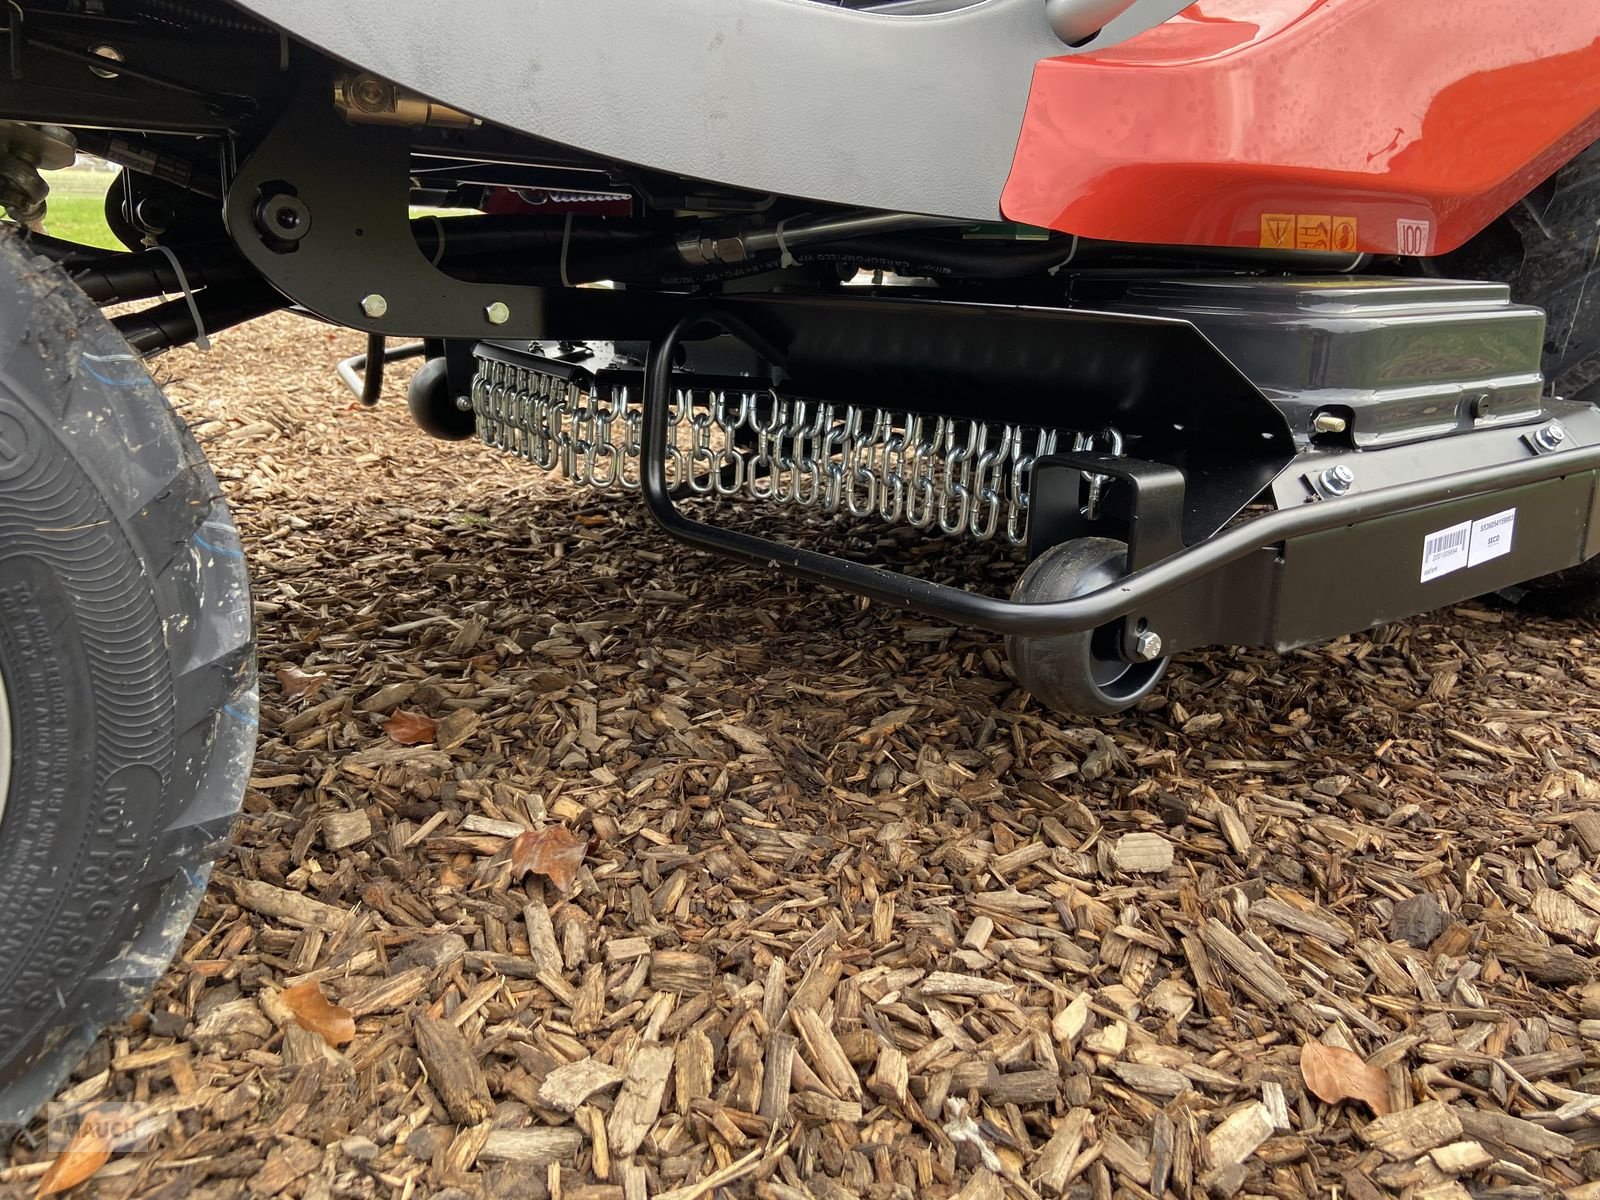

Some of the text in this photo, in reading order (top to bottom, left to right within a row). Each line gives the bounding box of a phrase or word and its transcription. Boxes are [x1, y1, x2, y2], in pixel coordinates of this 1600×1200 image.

[1487, 534, 1500, 545] SECO
[24, 608, 52, 650] AVOID
[53, 727, 69, 781] INJURY
[97, 786, 128, 834] NOT
[72, 851, 110, 899] FOR
